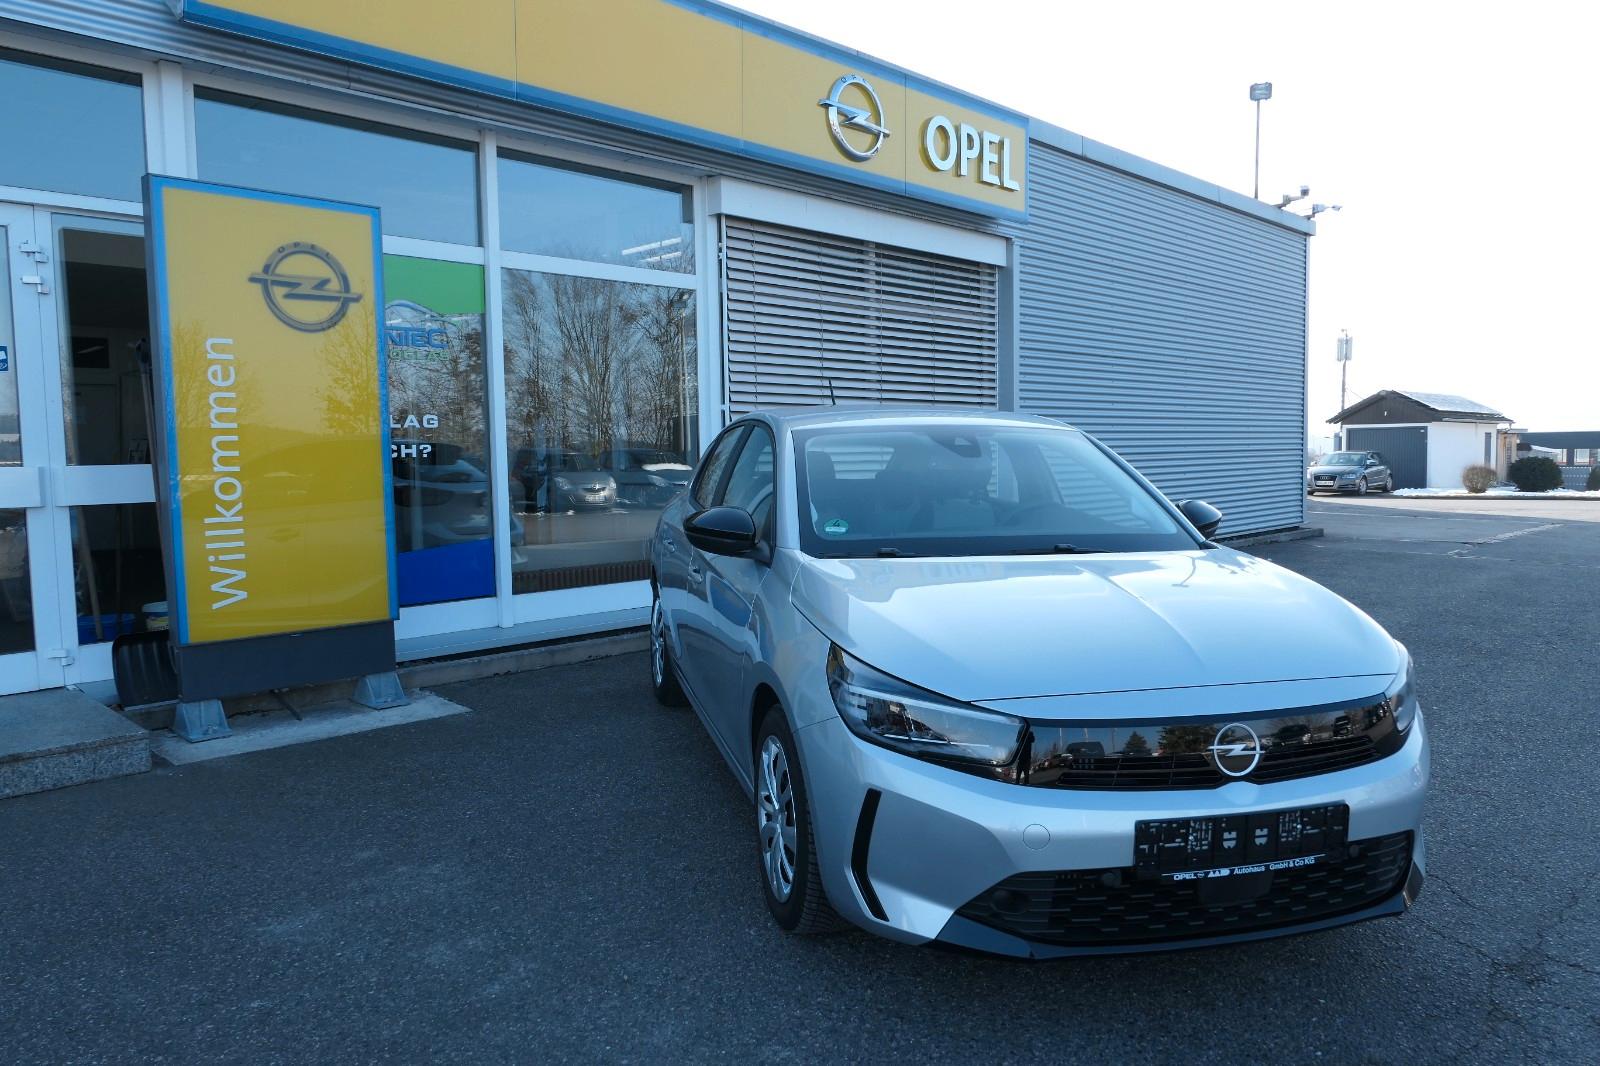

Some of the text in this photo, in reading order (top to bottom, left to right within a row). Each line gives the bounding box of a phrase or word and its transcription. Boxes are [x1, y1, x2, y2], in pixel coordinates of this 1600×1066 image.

[925, 115, 1021, 191] OPEL
[390, 414, 439, 429] LAG
[204, 337, 248, 610] Willkommen
[1173, 873, 1197, 881] OPEL
[1233, 865, 1266, 875] Autohaus
[1269, 861, 1289, 870] GmbH
[1294, 858, 1305, 867] Co
[1304, 856, 1316, 865] KG
